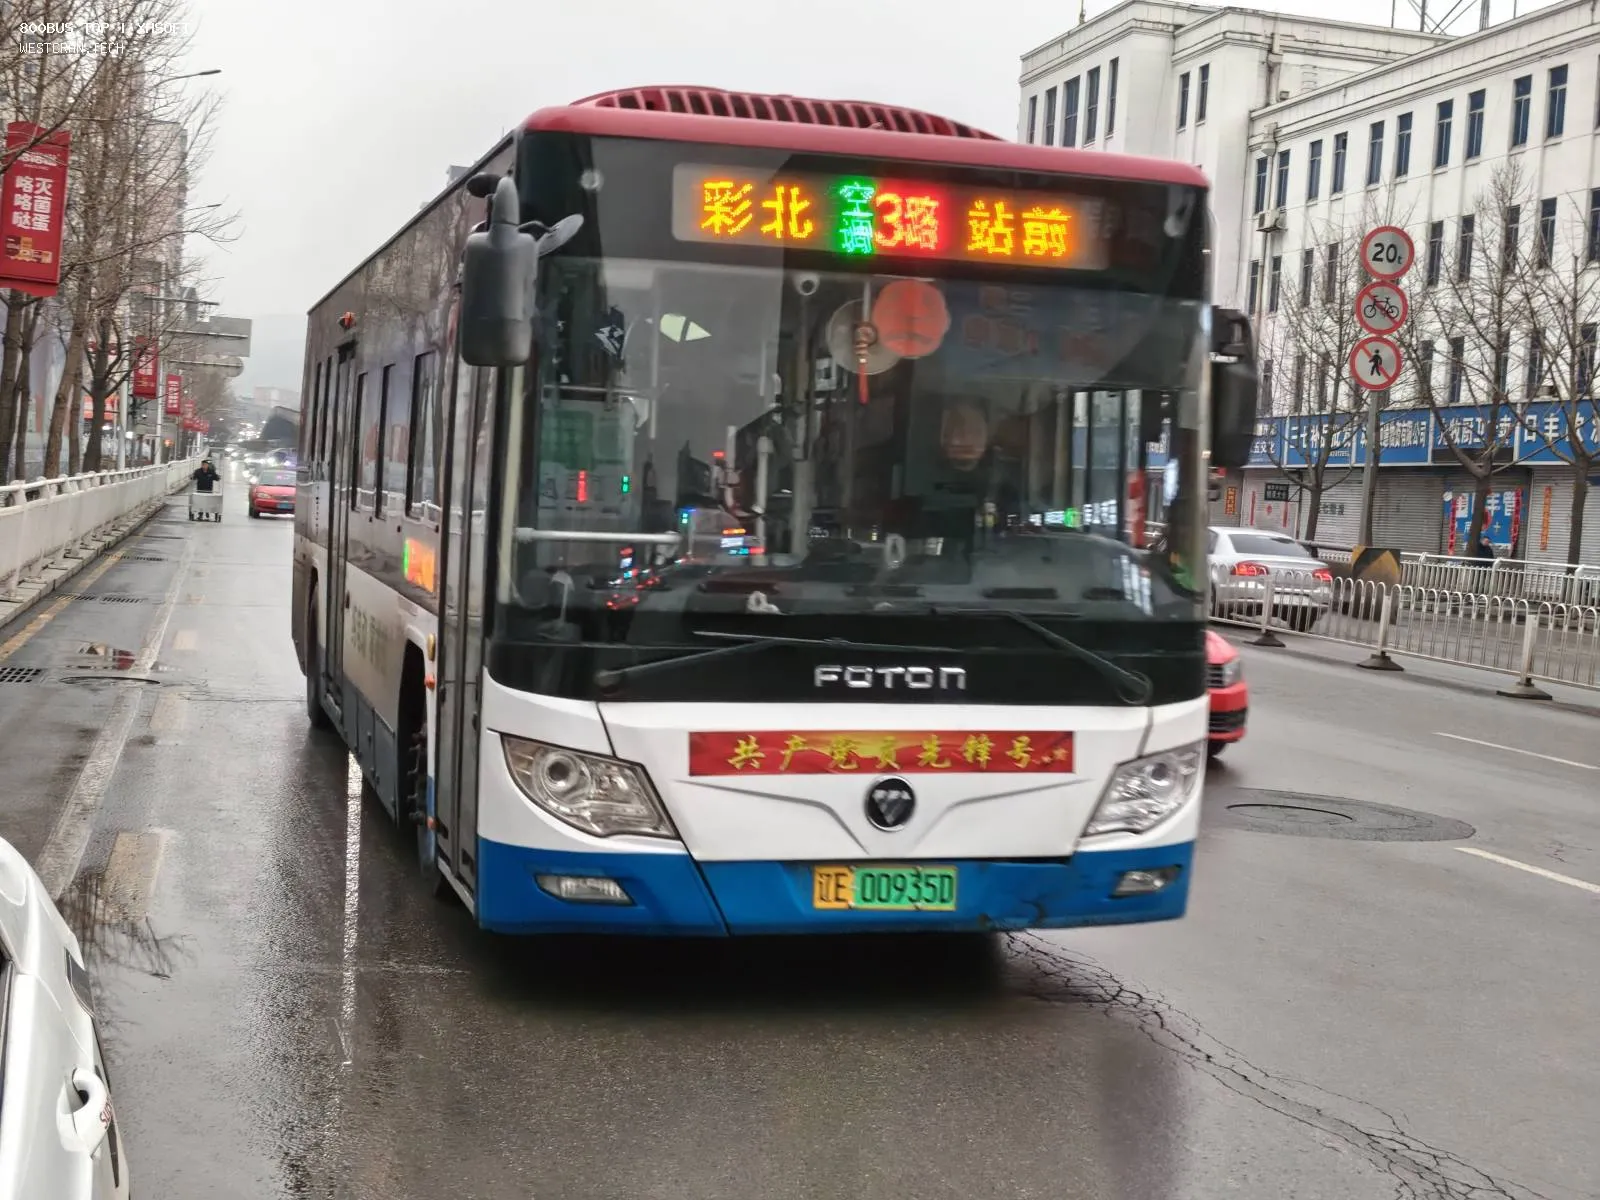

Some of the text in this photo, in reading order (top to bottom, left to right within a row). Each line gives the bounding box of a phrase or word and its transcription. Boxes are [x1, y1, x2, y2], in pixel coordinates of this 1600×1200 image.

[700, 180, 814, 239] 彩北
[967, 199, 1072, 258] 站前
[813, 664, 967, 690] FOTON
[727, 734, 1034, 770] 共产党员先锋号
